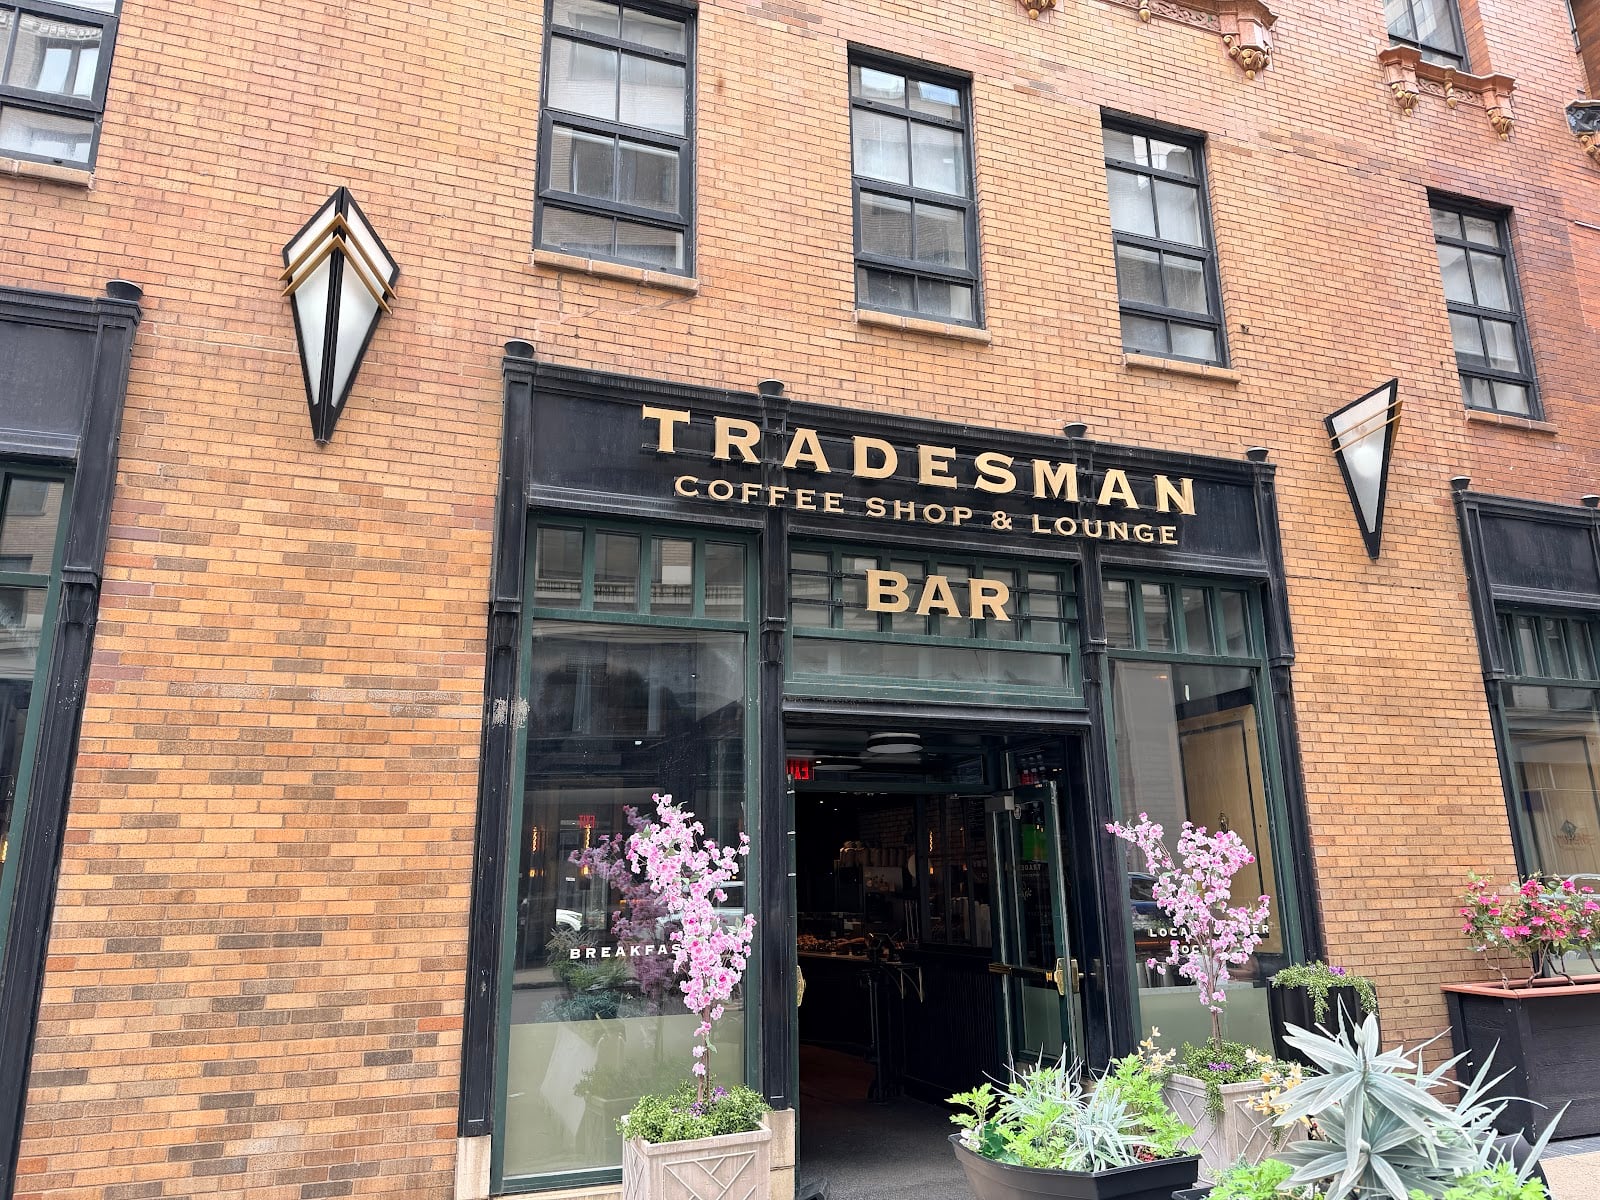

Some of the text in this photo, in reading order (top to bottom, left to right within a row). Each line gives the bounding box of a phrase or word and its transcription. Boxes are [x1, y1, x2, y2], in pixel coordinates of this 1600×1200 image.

[641, 404, 1197, 516] TRADESMAN
[673, 475, 1179, 545] COFFEE SHOP & LOUNGE
[865, 568, 1012, 622] BAR
[569, 943, 690, 960] BREAKFAS
[1149, 927, 1195, 938] LOCA
